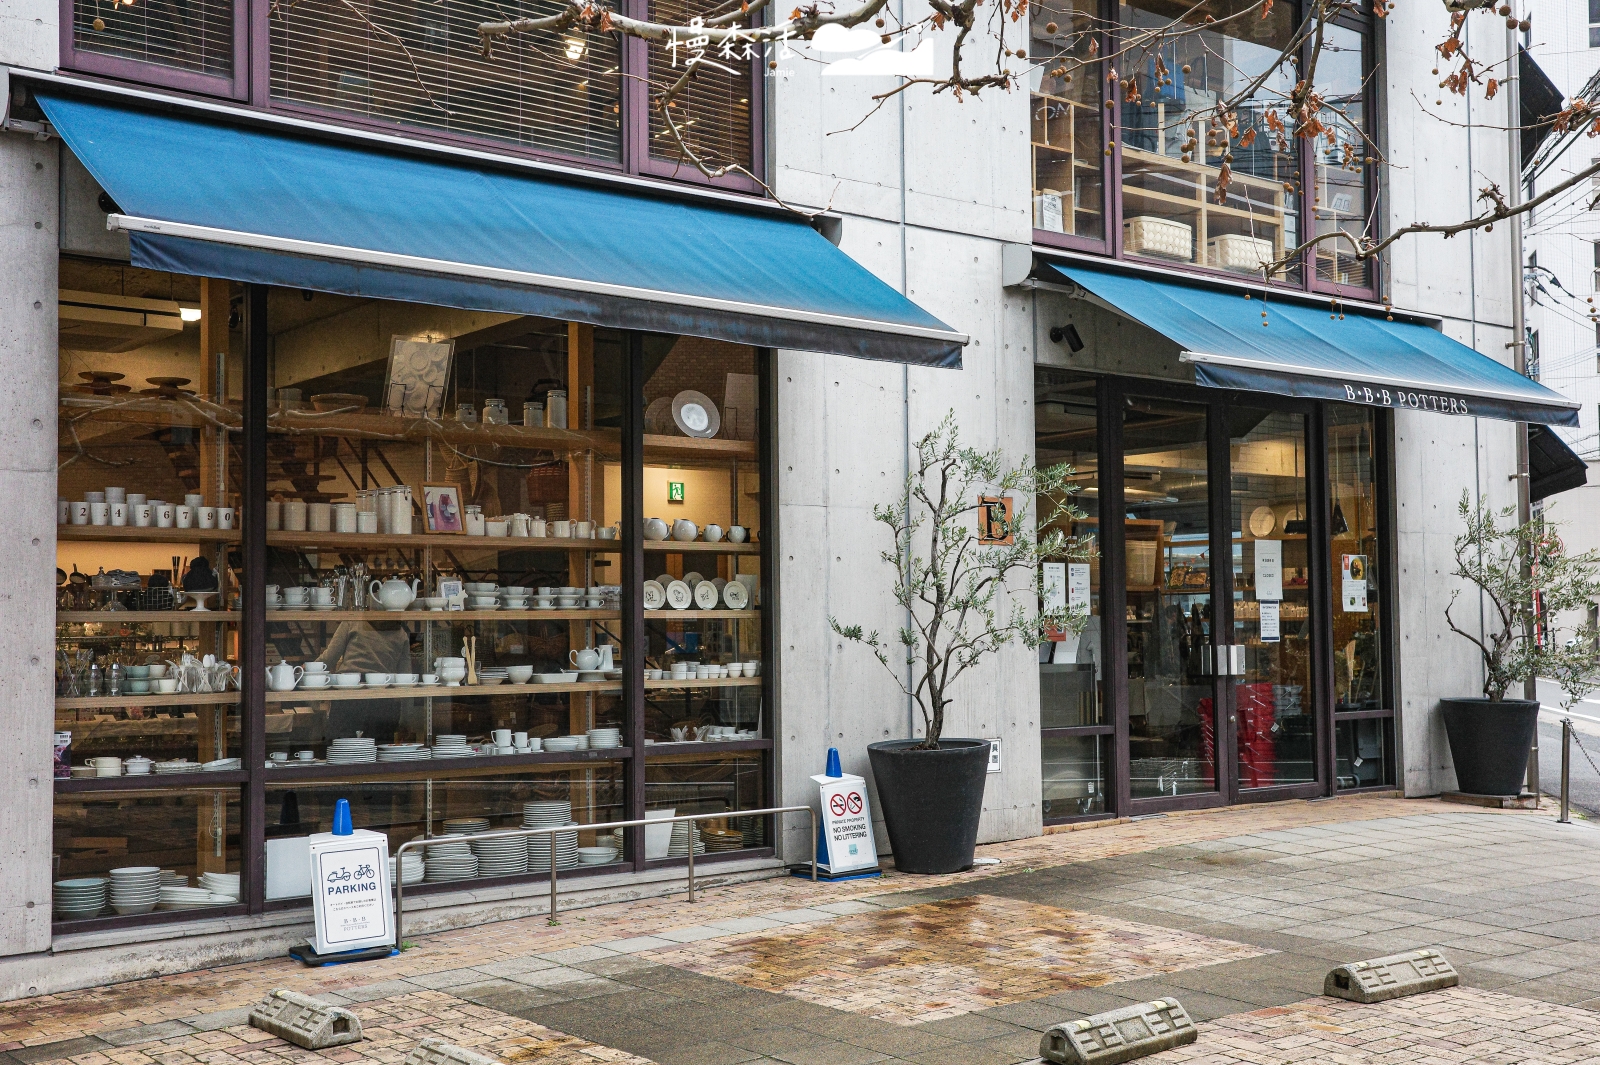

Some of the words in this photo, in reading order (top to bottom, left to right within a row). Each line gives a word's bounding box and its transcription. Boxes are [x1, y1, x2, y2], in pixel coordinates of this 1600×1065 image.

[1398, 391, 1468, 414] POTTERS
[80, 507, 87, 516] 2
[103, 508, 110, 517] 3
[114, 508, 122, 518] 4
[143, 509, 150, 518] 5
[164, 510, 170, 520] 6
[182, 511, 189, 520] 7
[207, 511, 214, 520] 9
[224, 512, 231, 521] 0
[984, 502, 1009, 540] B
[842, 824, 866, 832] SMOKING
[843, 831, 867, 840] LITTERING
[328, 882, 376, 895] PARKING
